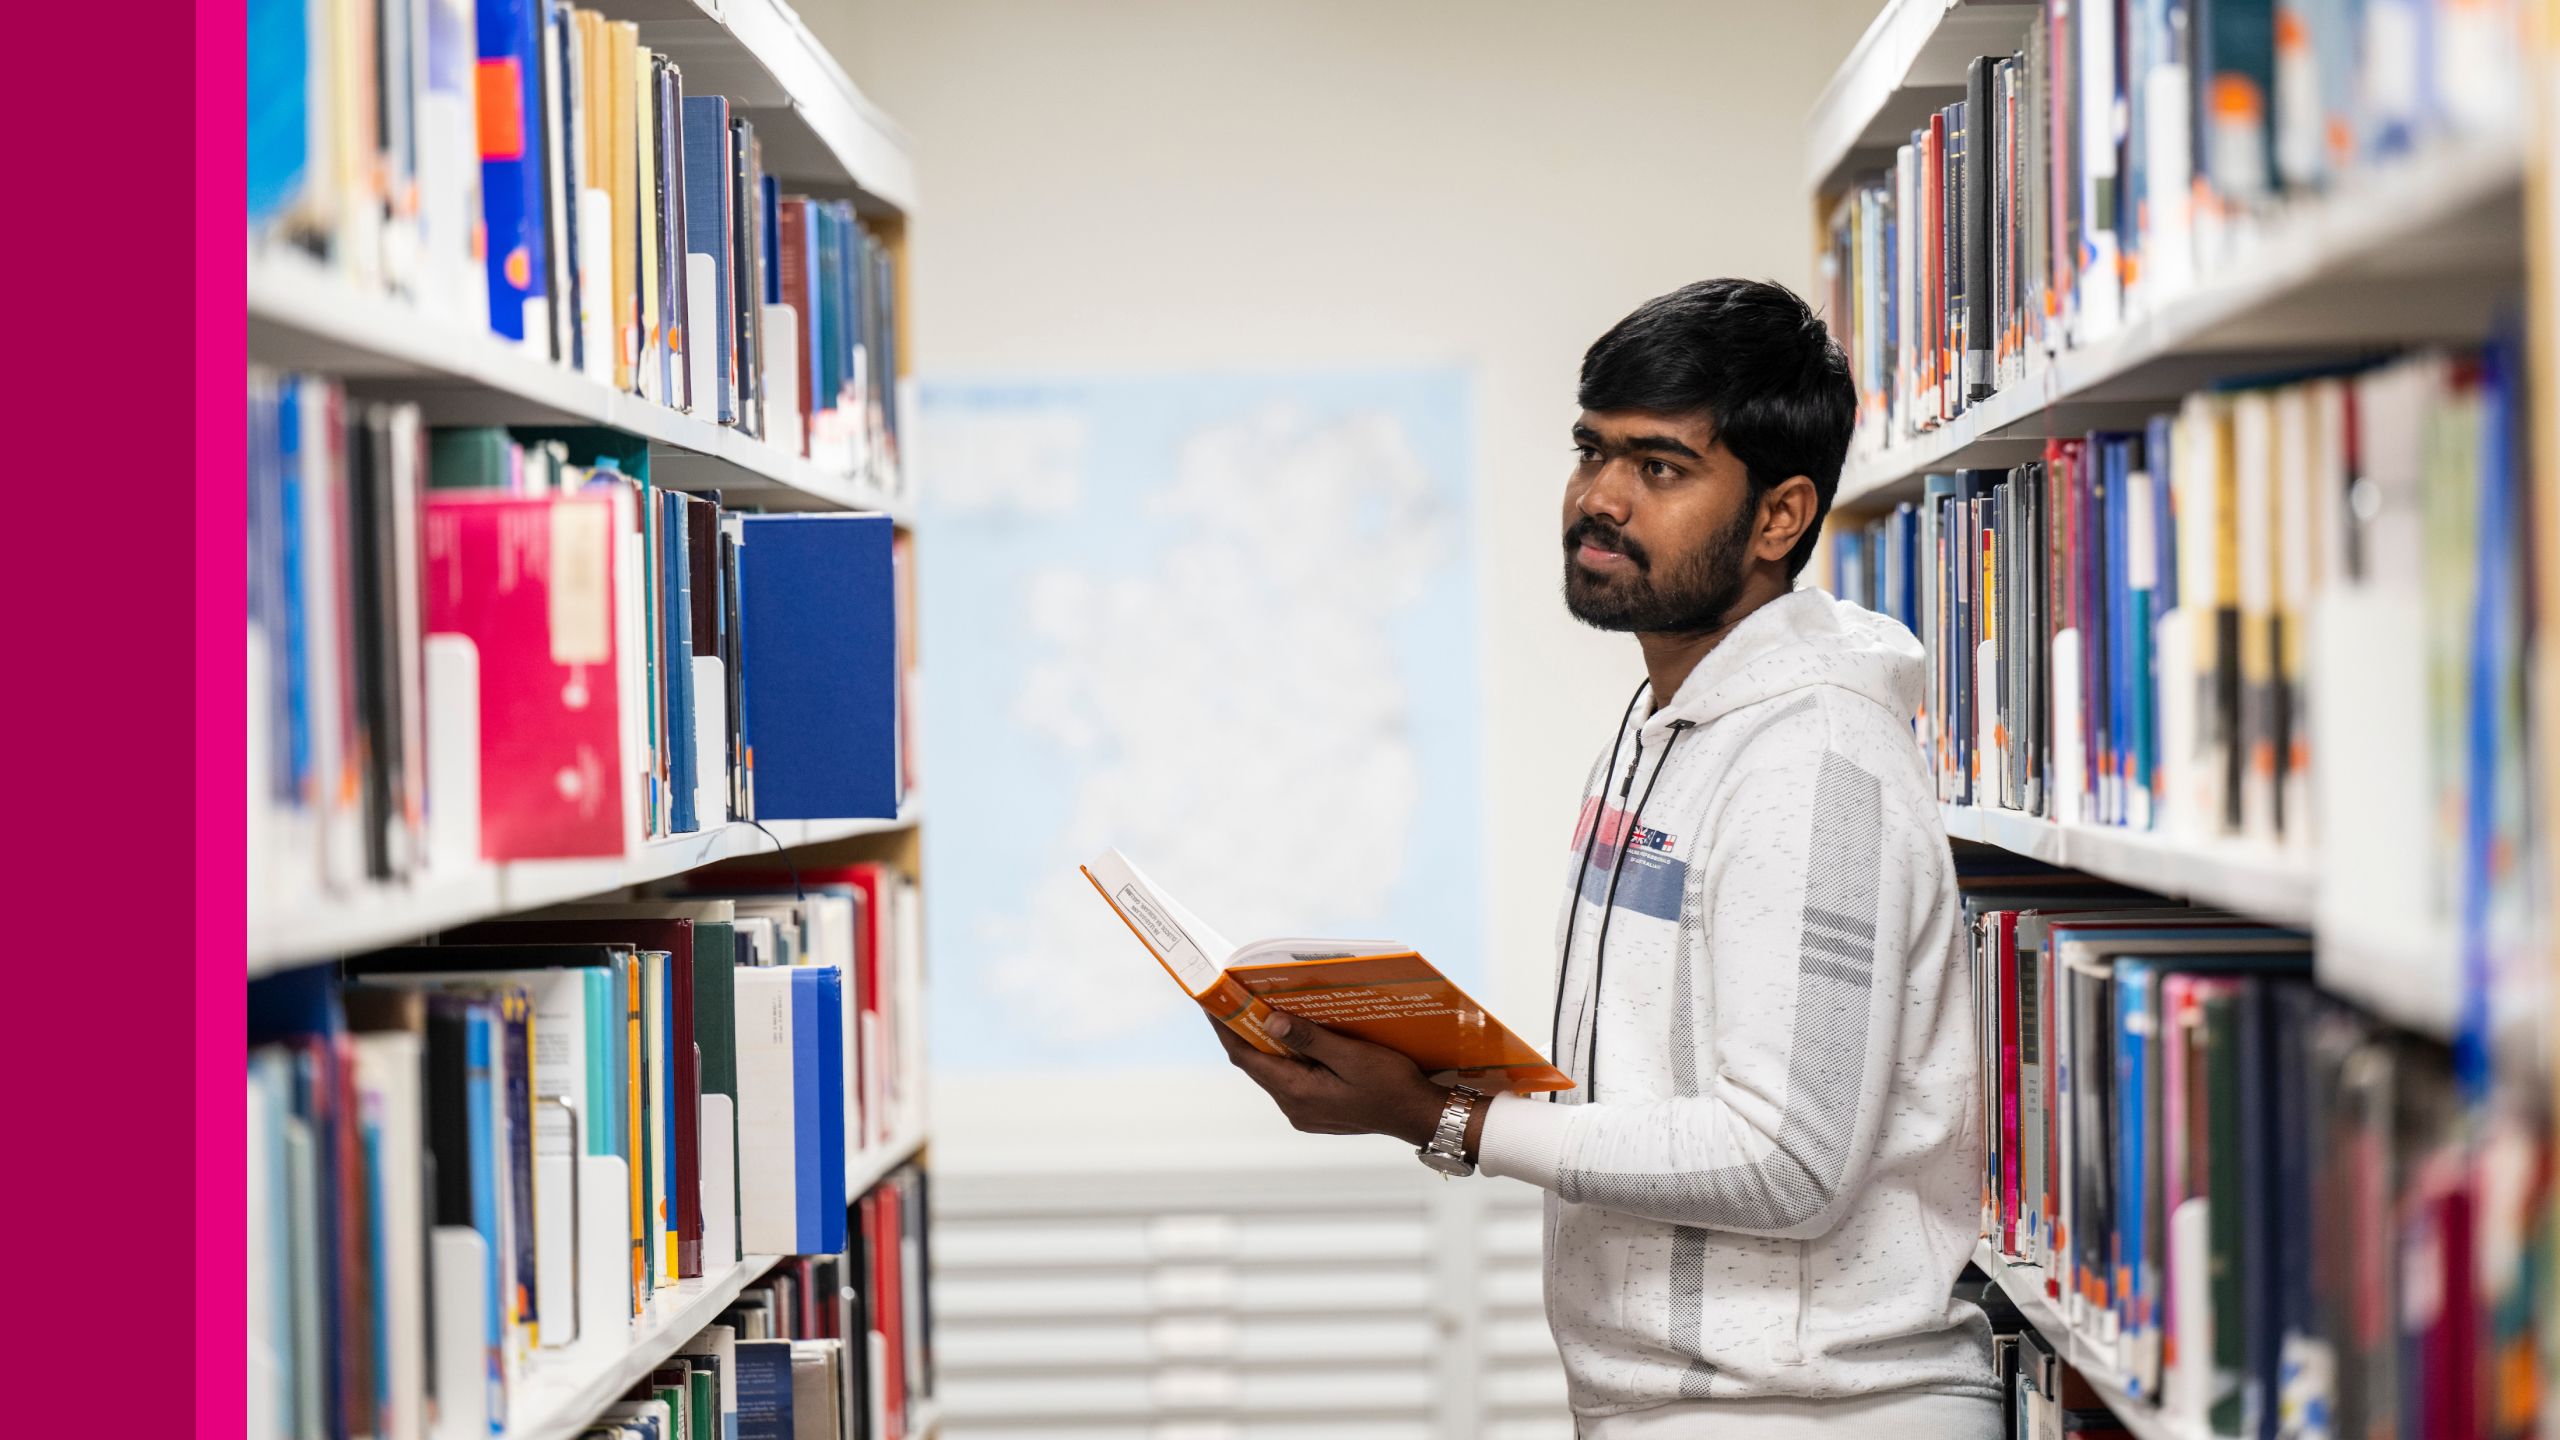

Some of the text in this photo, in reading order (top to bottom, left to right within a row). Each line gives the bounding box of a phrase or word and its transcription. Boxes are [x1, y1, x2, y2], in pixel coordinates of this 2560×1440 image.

[1264, 989, 1377, 1004] Managing Babel:
[1301, 997, 1391, 1009] International
[1392, 993, 1433, 1002] Legal
[1296, 1002, 1444, 1018] otection of Minorities
[1330, 1012, 1402, 1023] Twentieth
[1403, 1008, 1460, 1017] Century
